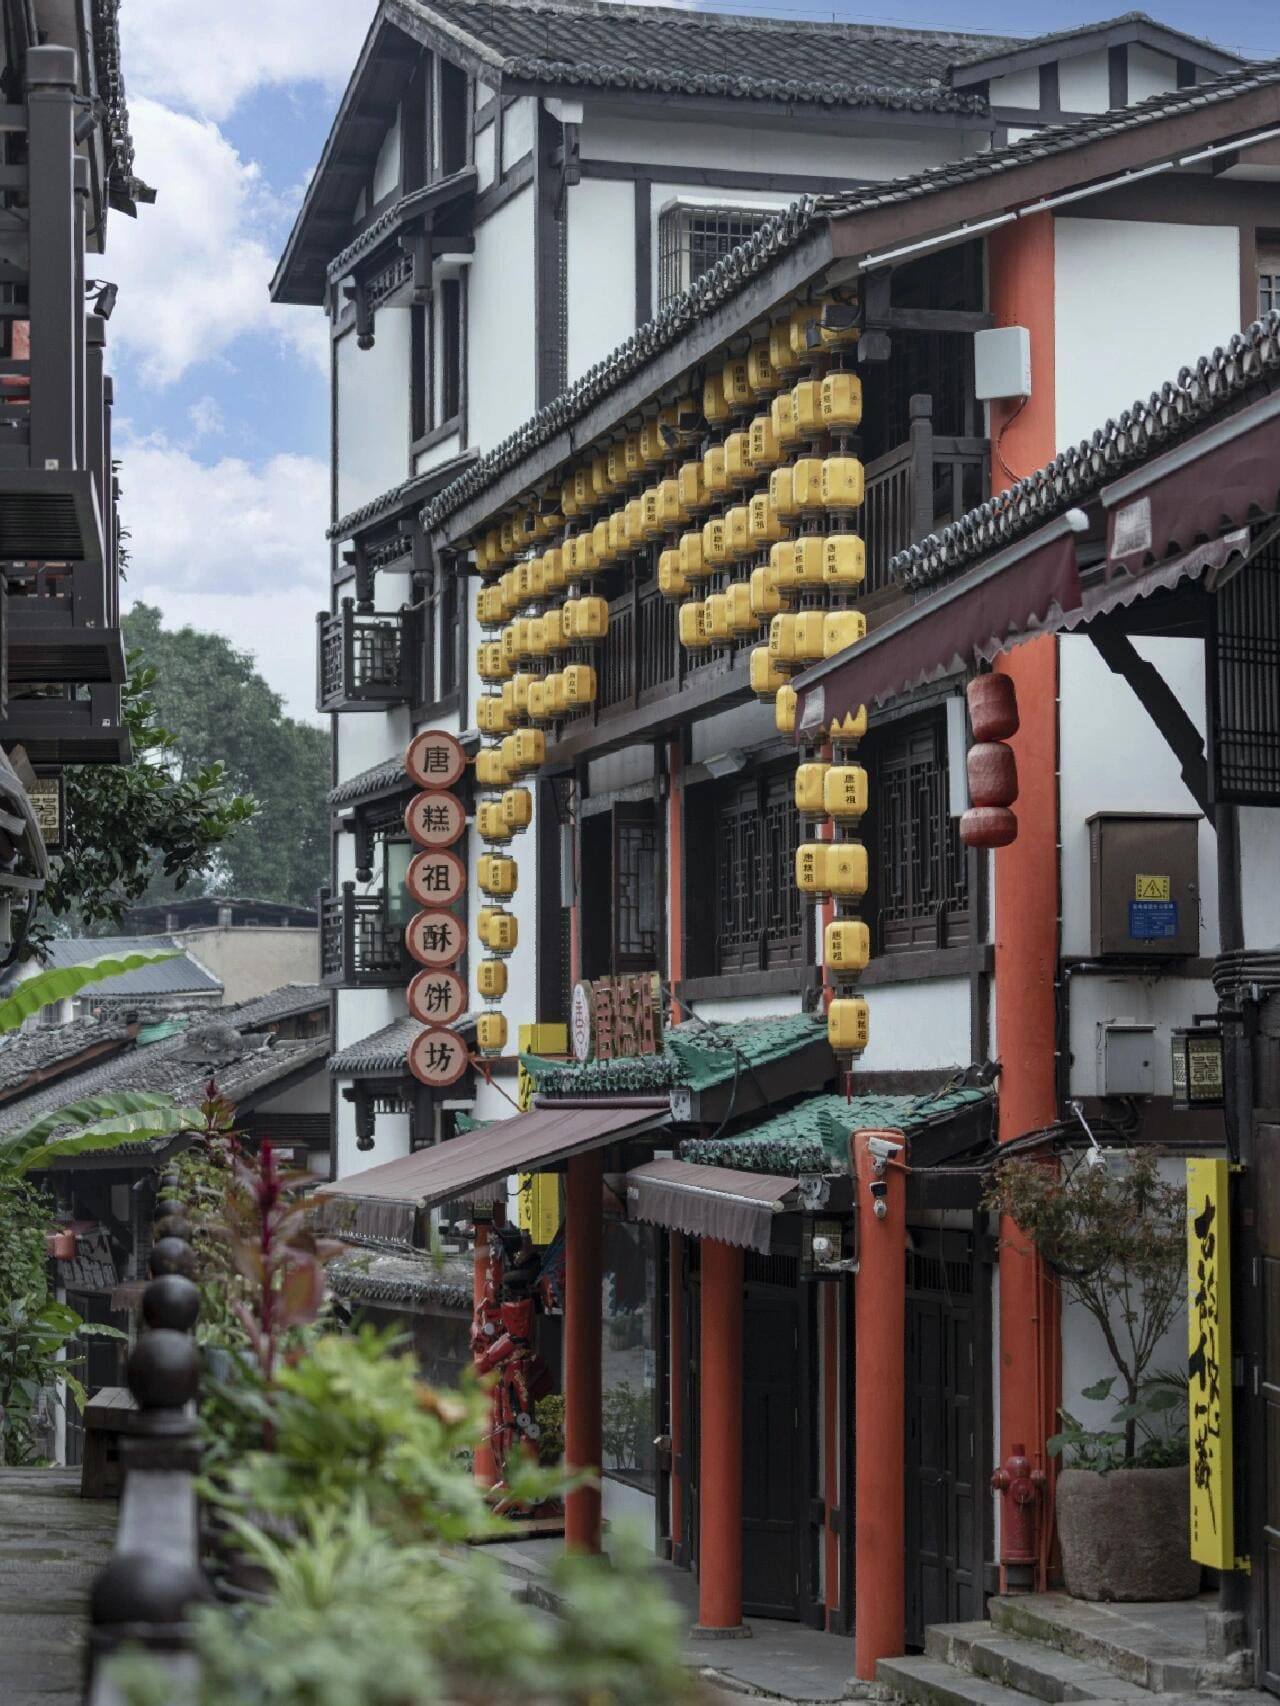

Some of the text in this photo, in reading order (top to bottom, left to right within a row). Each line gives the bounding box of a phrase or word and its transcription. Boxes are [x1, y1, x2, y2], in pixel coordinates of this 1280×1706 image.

[844, 773, 856, 804] 唐糕祖
[803, 852, 814, 883] 唐糕祖
[422, 747, 453, 1073] 唐糕祖酥饼坊
[832, 930, 842, 961] 唐糕祖
[857, 1009, 867, 1040] 唐糕祖
